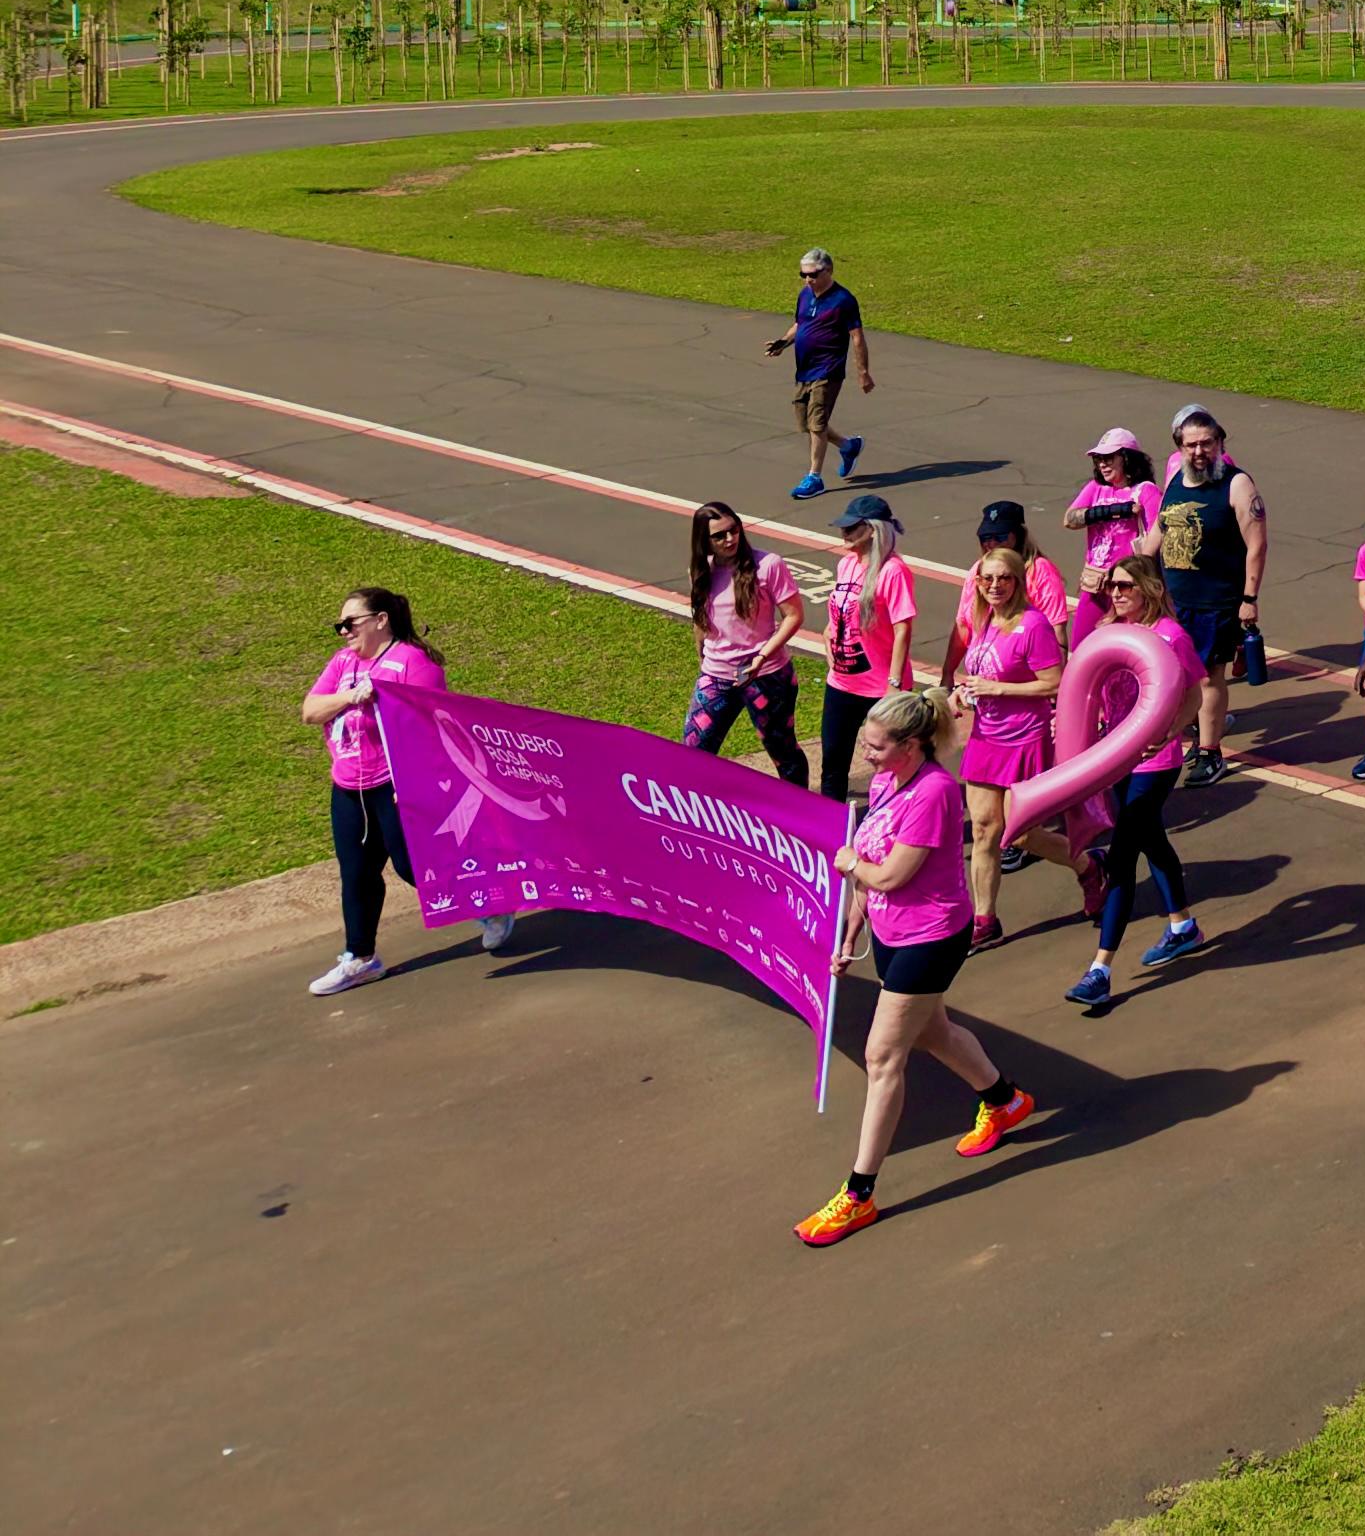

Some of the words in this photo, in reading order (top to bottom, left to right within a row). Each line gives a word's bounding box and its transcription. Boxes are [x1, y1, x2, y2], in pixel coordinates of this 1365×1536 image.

[472, 724, 564, 758] OUTUBRO
[484, 745, 532, 768] ROSA
[495, 762, 564, 789] CAMPINAS
[621, 772, 830, 907] CAMINHADA
[660, 835, 778, 894] OUTUBRO
[785, 885, 817, 945] ROSA
